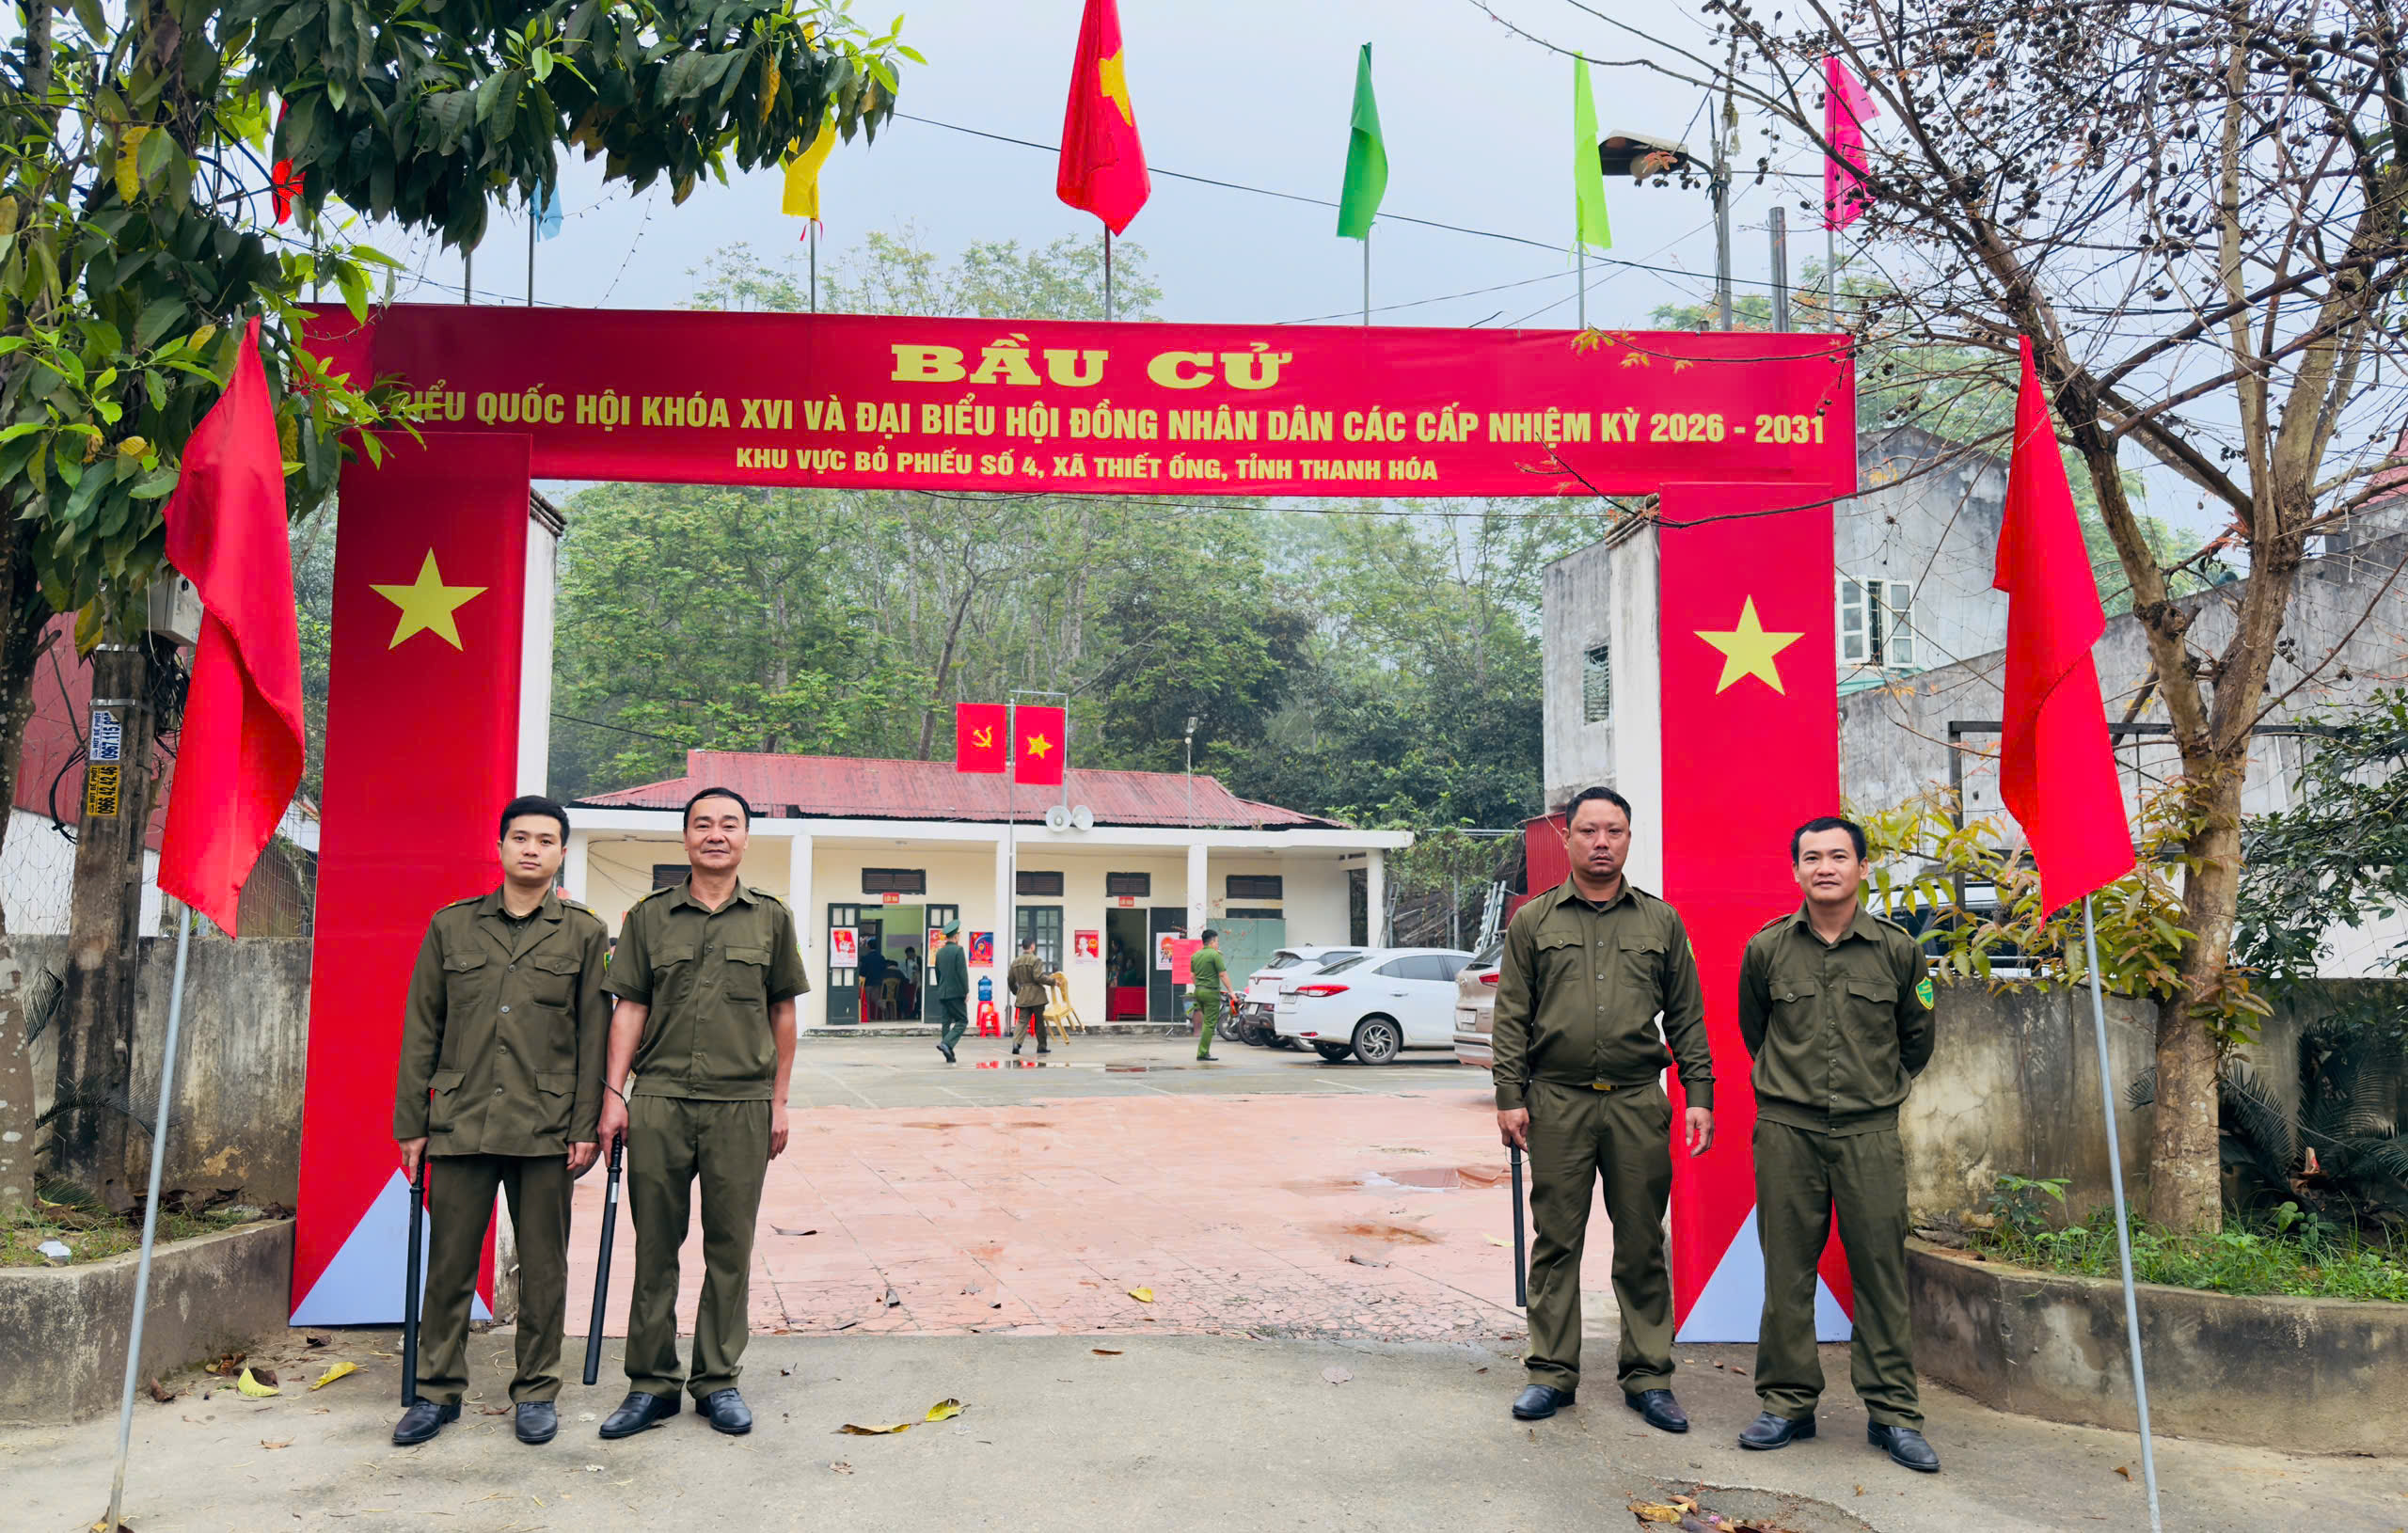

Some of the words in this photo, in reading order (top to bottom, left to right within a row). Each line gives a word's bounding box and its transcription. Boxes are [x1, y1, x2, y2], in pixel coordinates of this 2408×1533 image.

[891, 332, 1109, 387] BẦU
[1147, 342, 1293, 390] CỬ
[477, 383, 564, 425] QUỐC
[576, 388, 630, 432] HỘI
[642, 390, 731, 428] KHÓA
[740, 398, 793, 430] XVI
[804, 394, 847, 432] VÀ
[855, 402, 911, 440] ĐẠI
[921, 392, 996, 436] BIỂU
[1006, 400, 1060, 445] HỘI
[1069, 398, 1158, 440] ĐỒNG
[1168, 403, 1258, 441] NHÂN
[1267, 405, 1333, 441] DÂN
[1342, 405, 1406, 443] CÁC
[1416, 402, 1480, 443] CẤP
[1489, 406, 1592, 449] NHIỆM
[1601, 407, 1641, 443] KỲ
[1650, 413, 1725, 443] 2026
[1754, 414, 1824, 445] 2031
[737, 447, 788, 469] KHU
[797, 448, 847, 475] VỰC
[854, 445, 889, 473] BỎ
[896, 447, 973, 475] PHIẾU
[980, 449, 1015, 476] SỐ
[1022, 456, 1045, 479] 4,
[1053, 452, 1087, 478] XÃ
[1093, 451, 1163, 479] THIẾT
[1169, 451, 1228, 482] ỐNG,
[1235, 452, 1292, 481] TỈNH
[1298, 459, 1382, 481] THANH
[1388, 456, 1438, 481] HÓA
